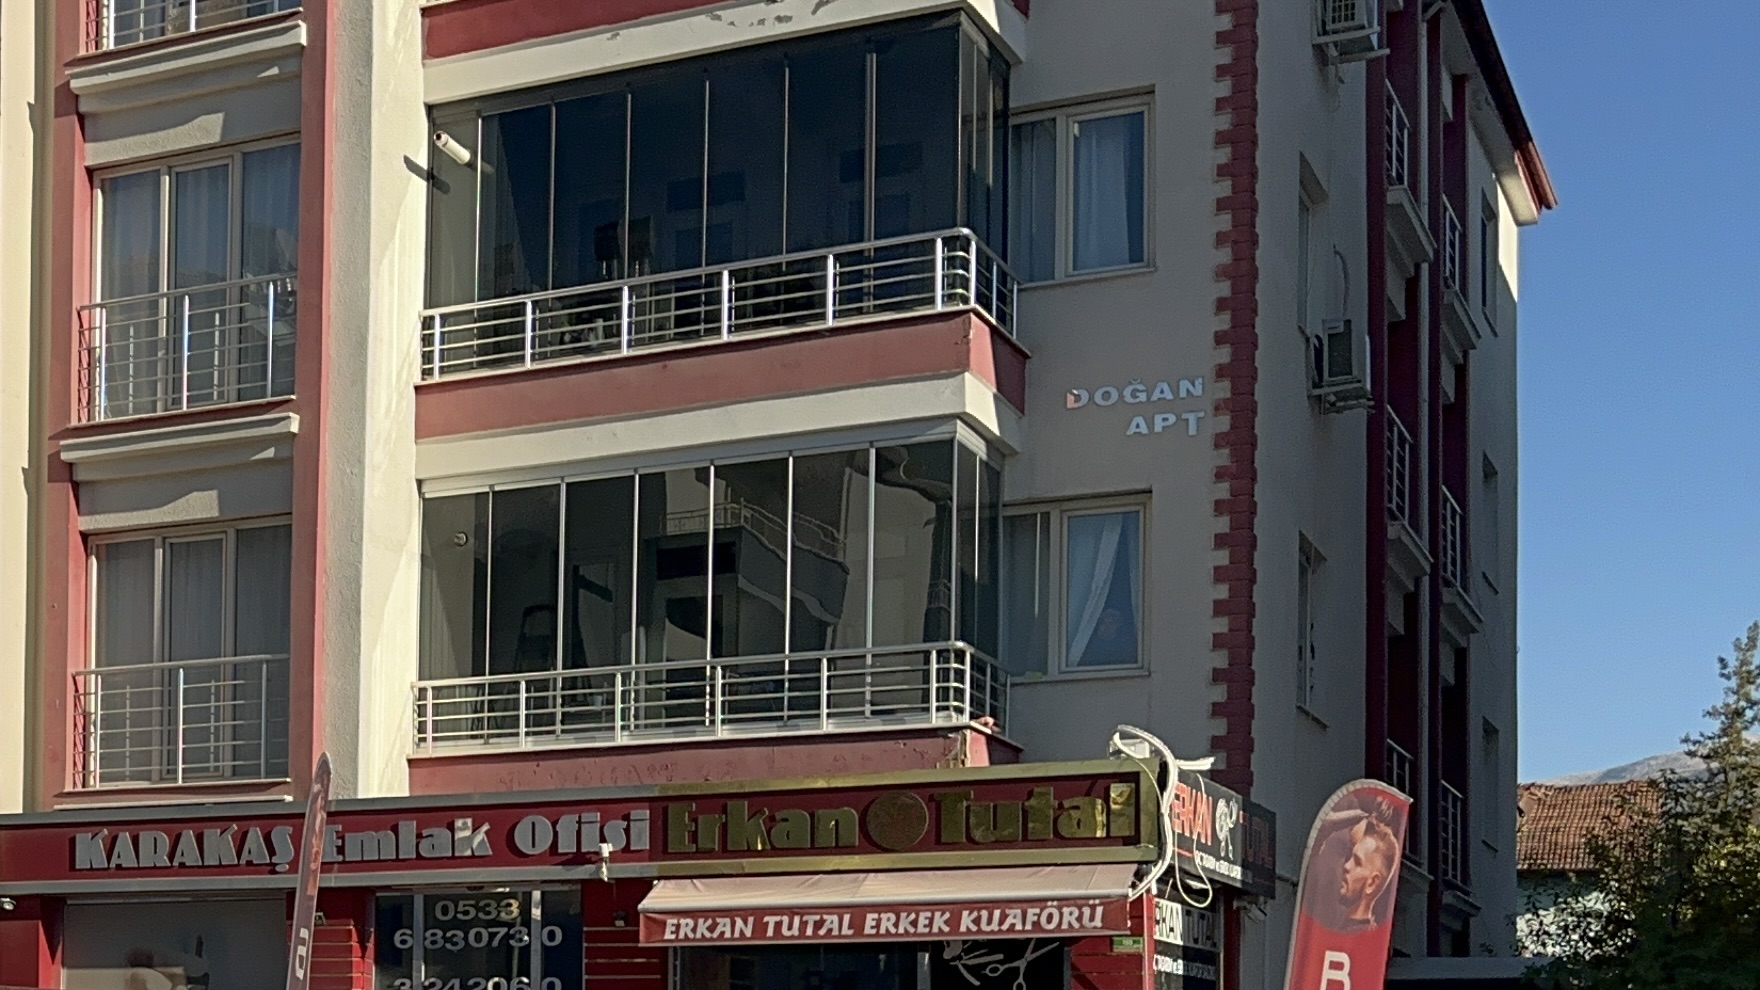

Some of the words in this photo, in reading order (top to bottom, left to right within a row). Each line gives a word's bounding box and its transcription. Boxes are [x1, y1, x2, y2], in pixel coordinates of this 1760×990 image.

[1066, 377, 1203, 409] DOĞAN
[1126, 411, 1205, 436] APT
[667, 800, 859, 853] Erkan
[937, 782, 1136, 845] Tutal
[75, 824, 295, 873] KARAKAŞ
[322, 817, 493, 862] Emlak
[513, 809, 650, 855] Ofisi
[434, 898, 521, 921] 0533
[663, 915, 755, 940] ERKAN
[763, 912, 855, 938] TUTAL
[863, 910, 951, 935] ERKEK
[959, 900, 1104, 933] KUAFÖRÜ
